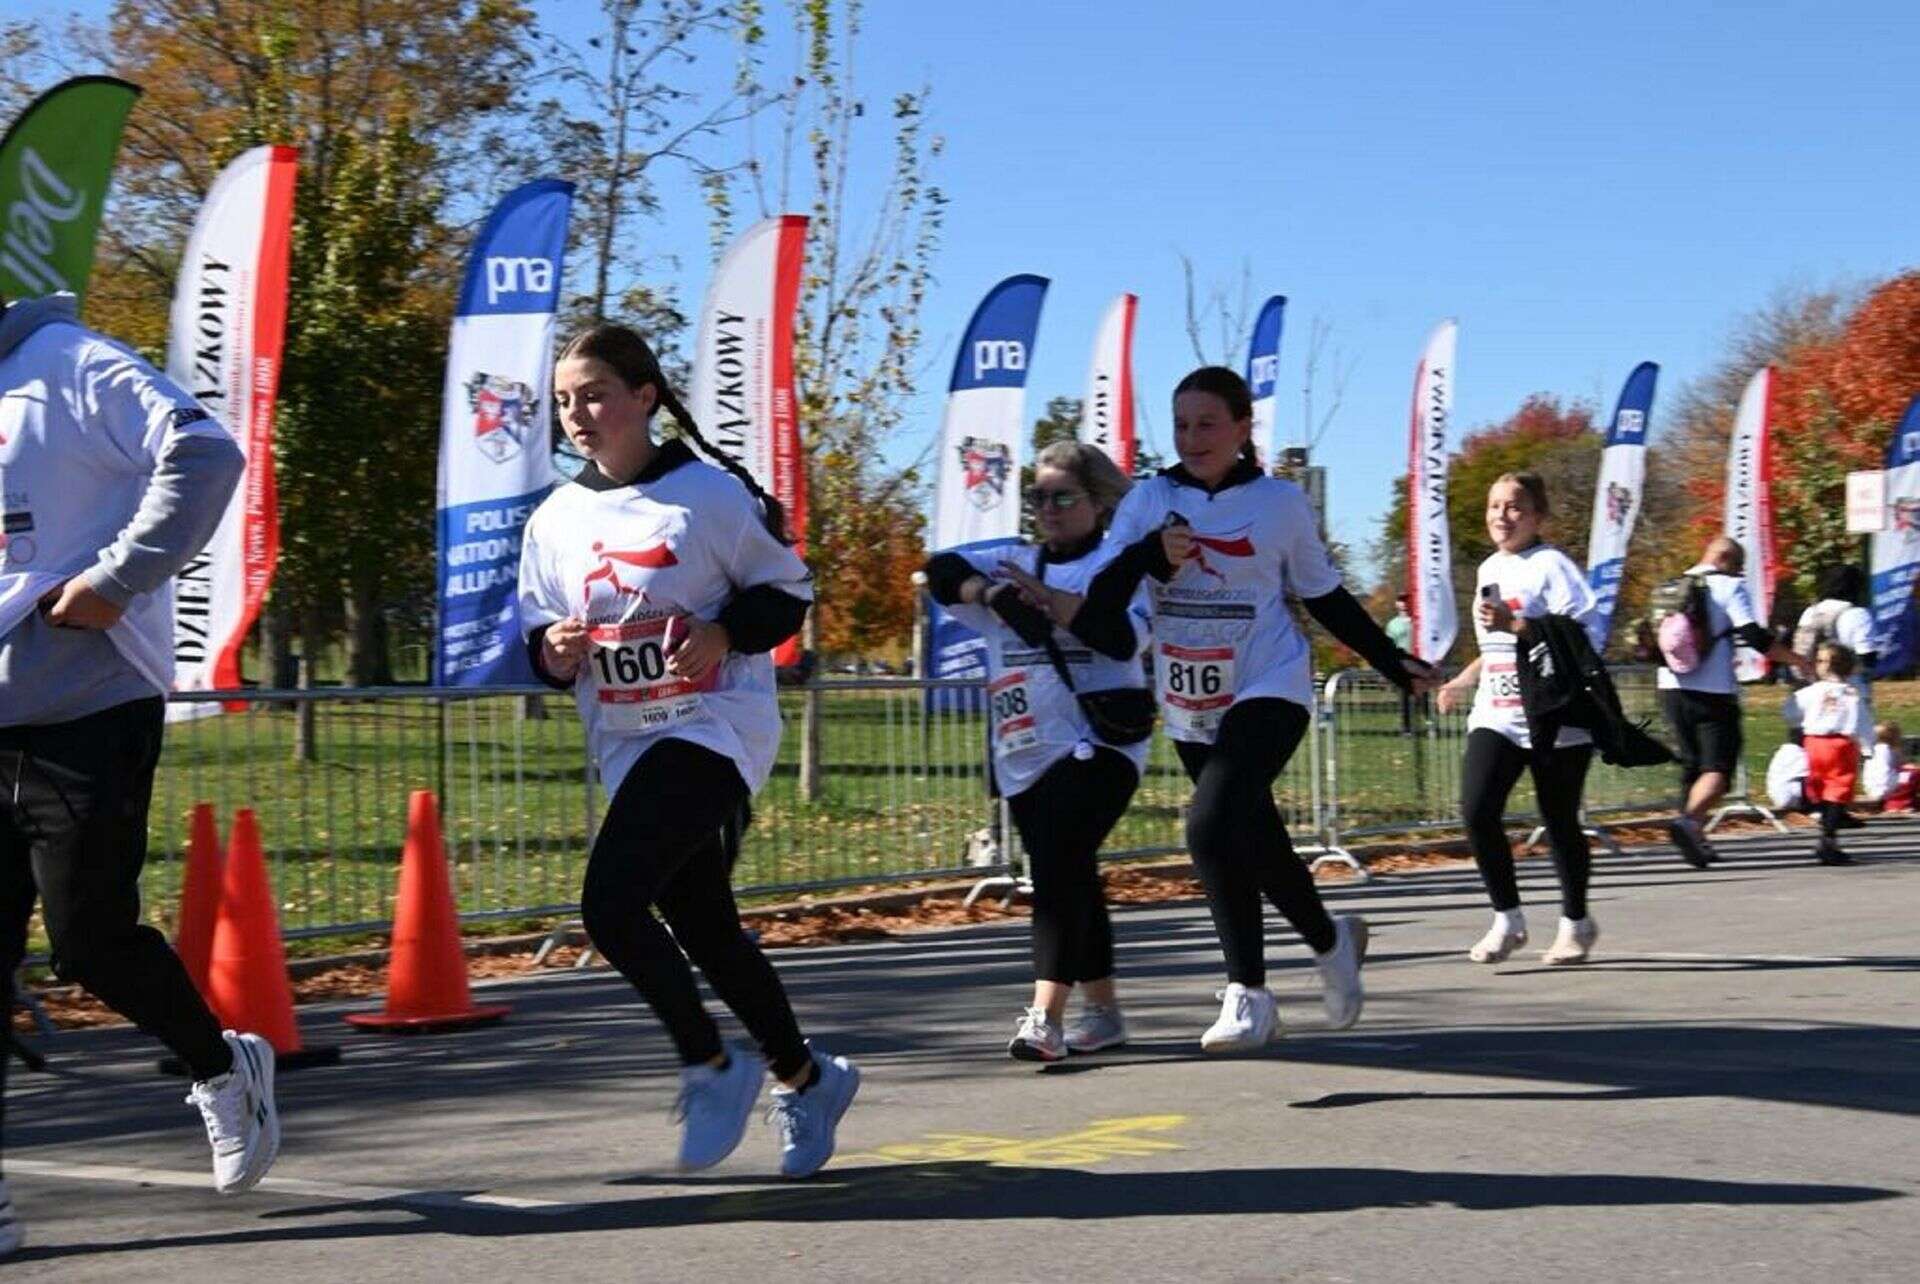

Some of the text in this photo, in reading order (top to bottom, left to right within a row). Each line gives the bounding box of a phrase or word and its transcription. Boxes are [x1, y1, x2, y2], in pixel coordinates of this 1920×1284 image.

[486, 256, 553, 305] pna
[974, 339, 1026, 380] pna
[174, 552, 213, 663] DZIEN
[593, 641, 665, 684] 160
[1169, 661, 1221, 695] 816
